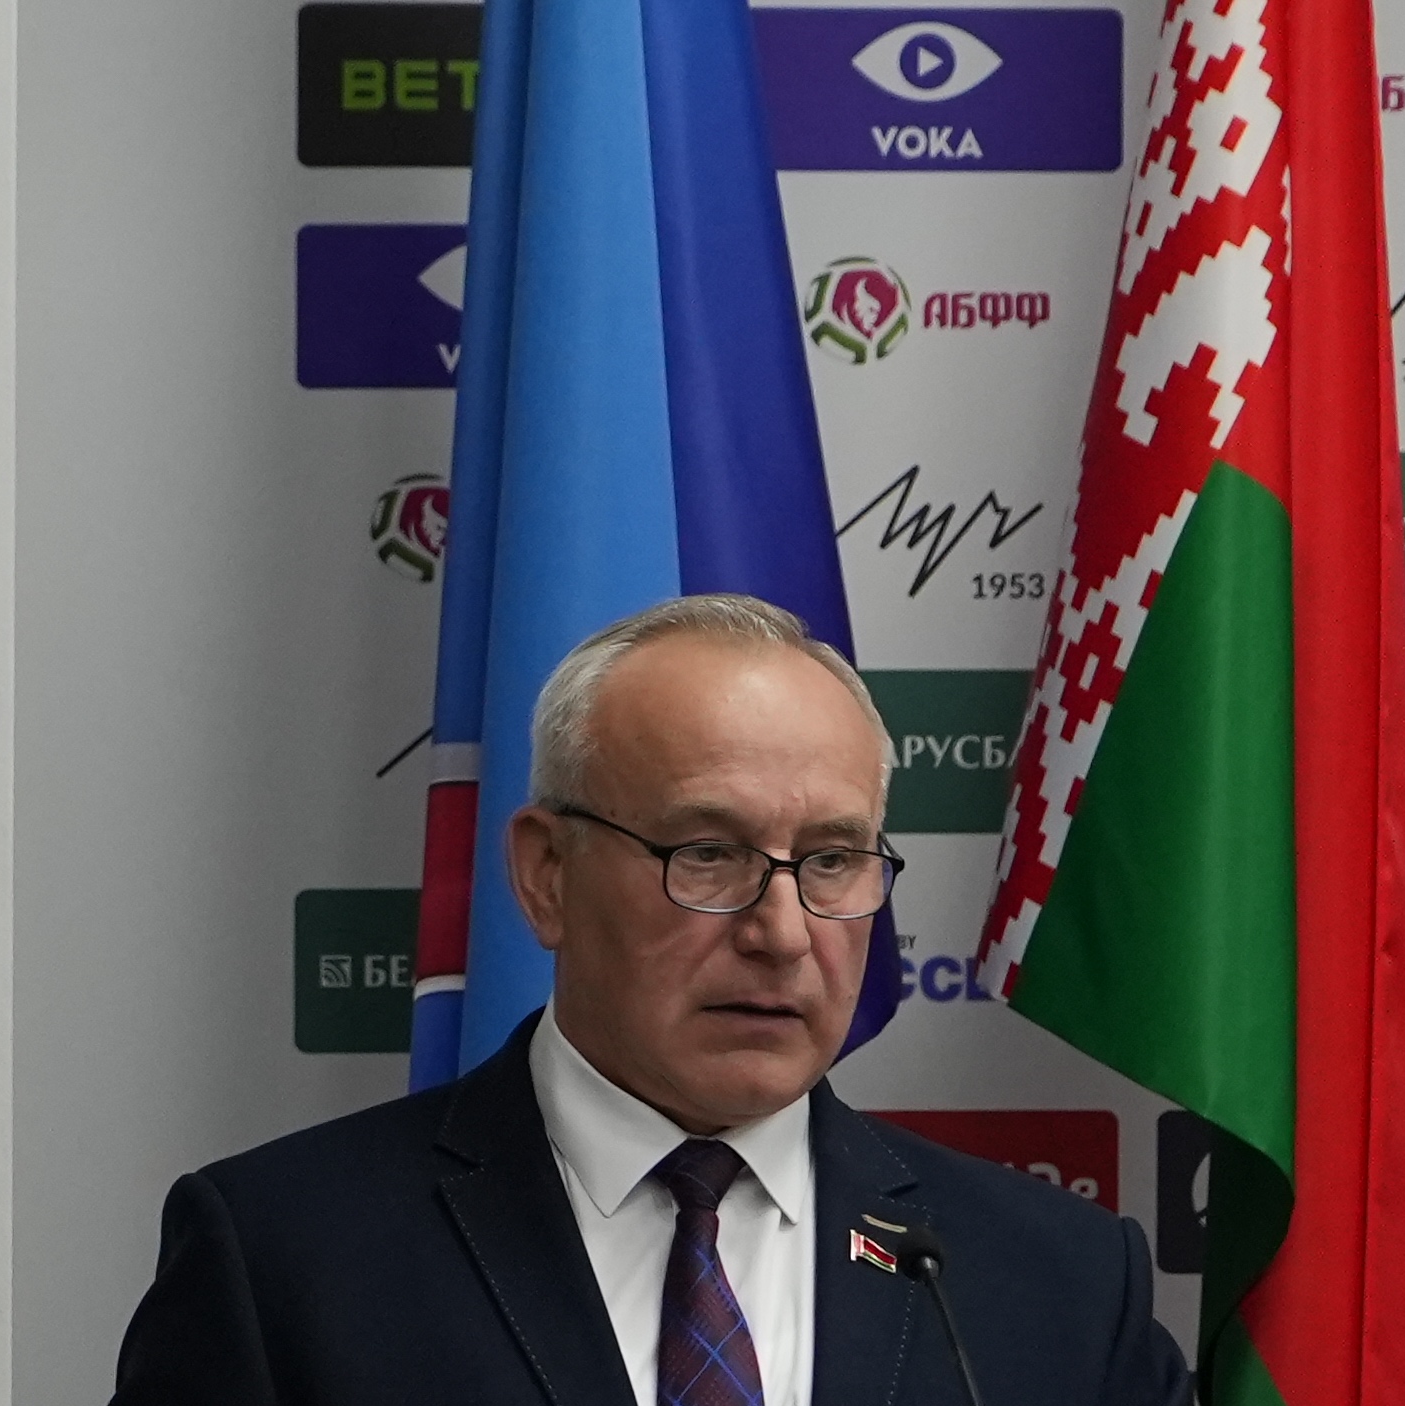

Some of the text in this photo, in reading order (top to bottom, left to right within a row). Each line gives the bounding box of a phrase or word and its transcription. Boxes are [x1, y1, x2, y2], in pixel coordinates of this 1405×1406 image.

[871, 125, 983, 159] VOKA
[922, 291, 1051, 330] АБФФ
[972, 573, 1045, 600] 1953
[894, 734, 1016, 769] РУСБ
